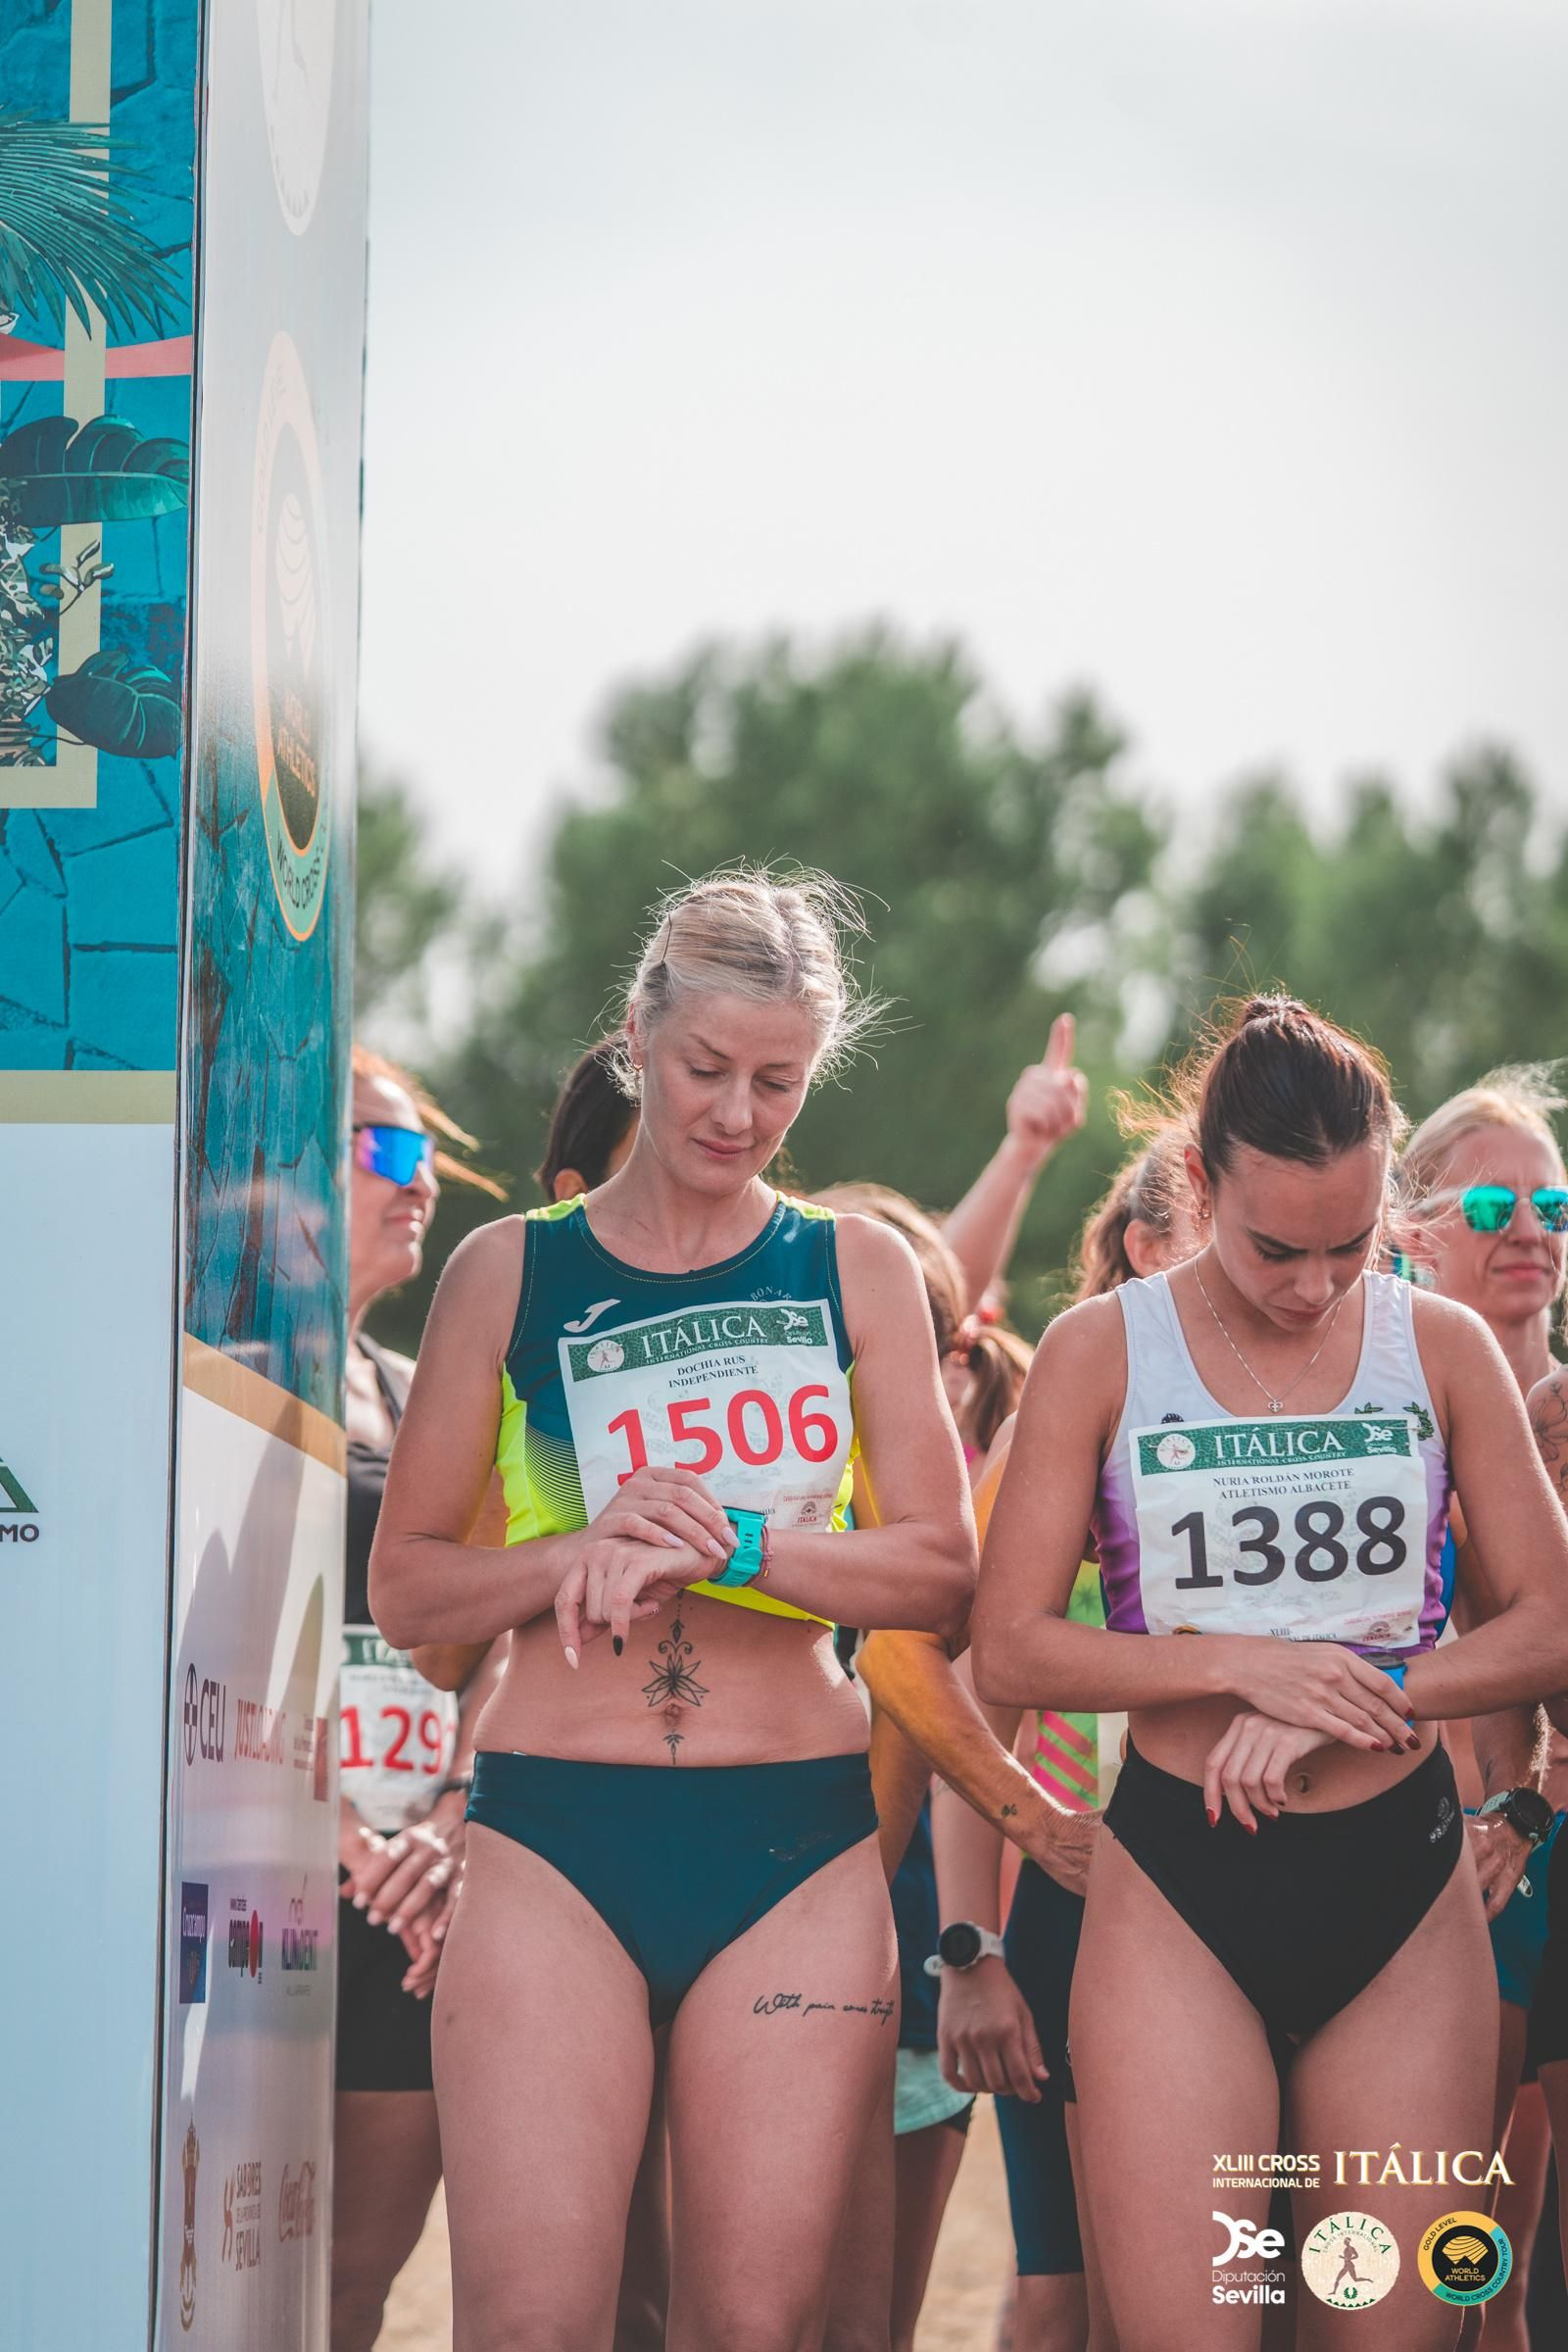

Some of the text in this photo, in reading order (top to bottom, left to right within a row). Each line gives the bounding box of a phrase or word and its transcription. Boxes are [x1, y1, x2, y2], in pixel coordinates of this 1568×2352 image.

[277, 831, 300, 907] WORLD
[640, 1316, 768, 1358] ITÁLICA
[646, 1337, 769, 1364] INTERNATIONAL CROSS COUNTRY
[786, 1336, 813, 1345] Sevilla
[668, 1365, 760, 1388] INDEPENDIENTE
[676, 1354, 746, 1376] DOCHIA RUS
[608, 1384, 838, 1488] 1506
[1214, 1427, 1346, 1459] ITÁLICA
[1217, 1458, 1281, 1467] INTERNATIONAL
[1308, 1451, 1347, 1461] COUNTRY
[1212, 1468, 1355, 1488] NURIA ROLDÁN MOROTE
[1218, 1481, 1351, 1499] ATLETISMO ALBACETE
[1171, 1495, 1407, 1590] 1388
[200, 1678, 226, 1763] CEU
[340, 1704, 455, 1776] 129
[182, 1905, 207, 1944] Cruzcampo
[802, 2001, 836, 2018] pain
[236, 2160, 262, 2198] SABORES
[235, 2229, 262, 2273] SEVILLA
